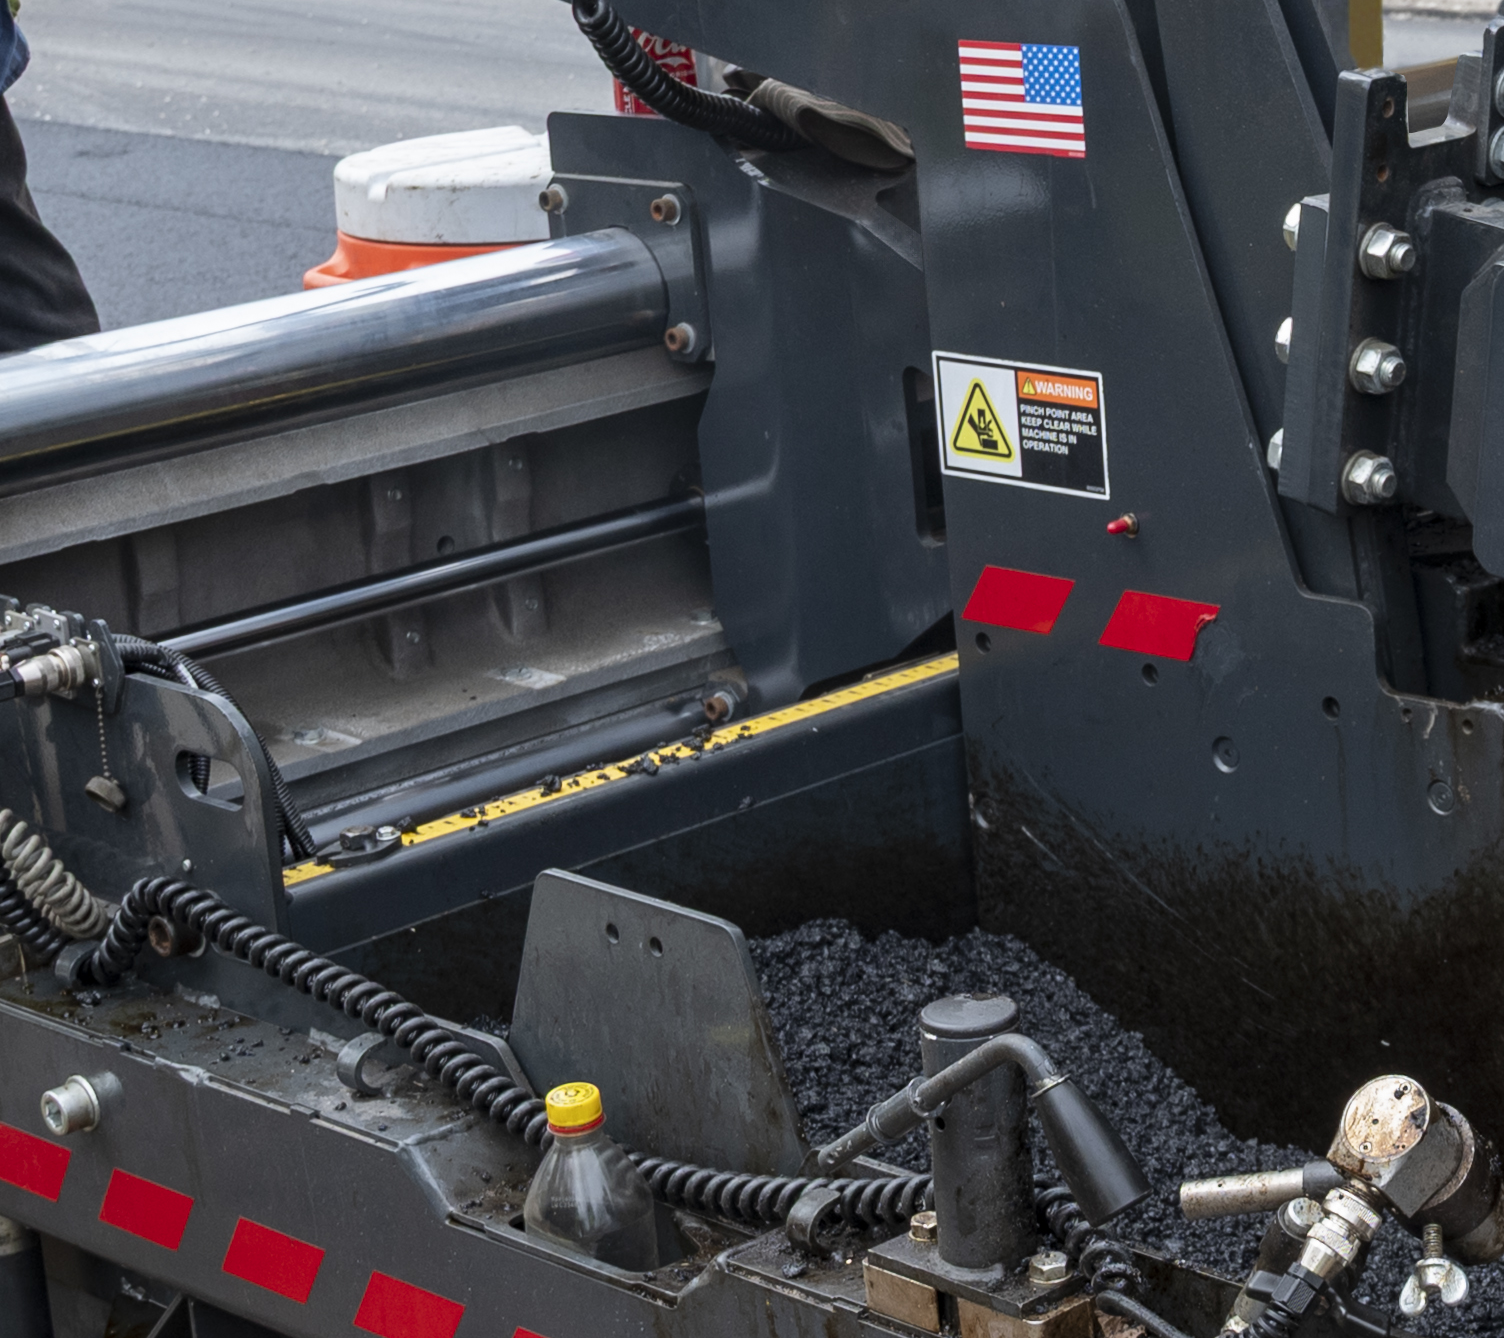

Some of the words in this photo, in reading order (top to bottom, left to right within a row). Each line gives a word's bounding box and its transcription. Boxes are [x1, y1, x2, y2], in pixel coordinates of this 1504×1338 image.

[1035, 380, 1094, 401] WARNING
[1020, 404, 1044, 416] PINCH
[1045, 407, 1069, 420] POINT
[1071, 411, 1094, 423] AREA
[1021, 416, 1042, 428] KEEP
[1043, 419, 1070, 432] CLEAR
[1071, 423, 1098, 436] WHILE
[1022, 427, 1058, 442] MACHINE
[1058, 433, 1067, 443] IS
[1068, 434, 1077, 444] IN
[1022, 439, 1069, 455] OPERATION
